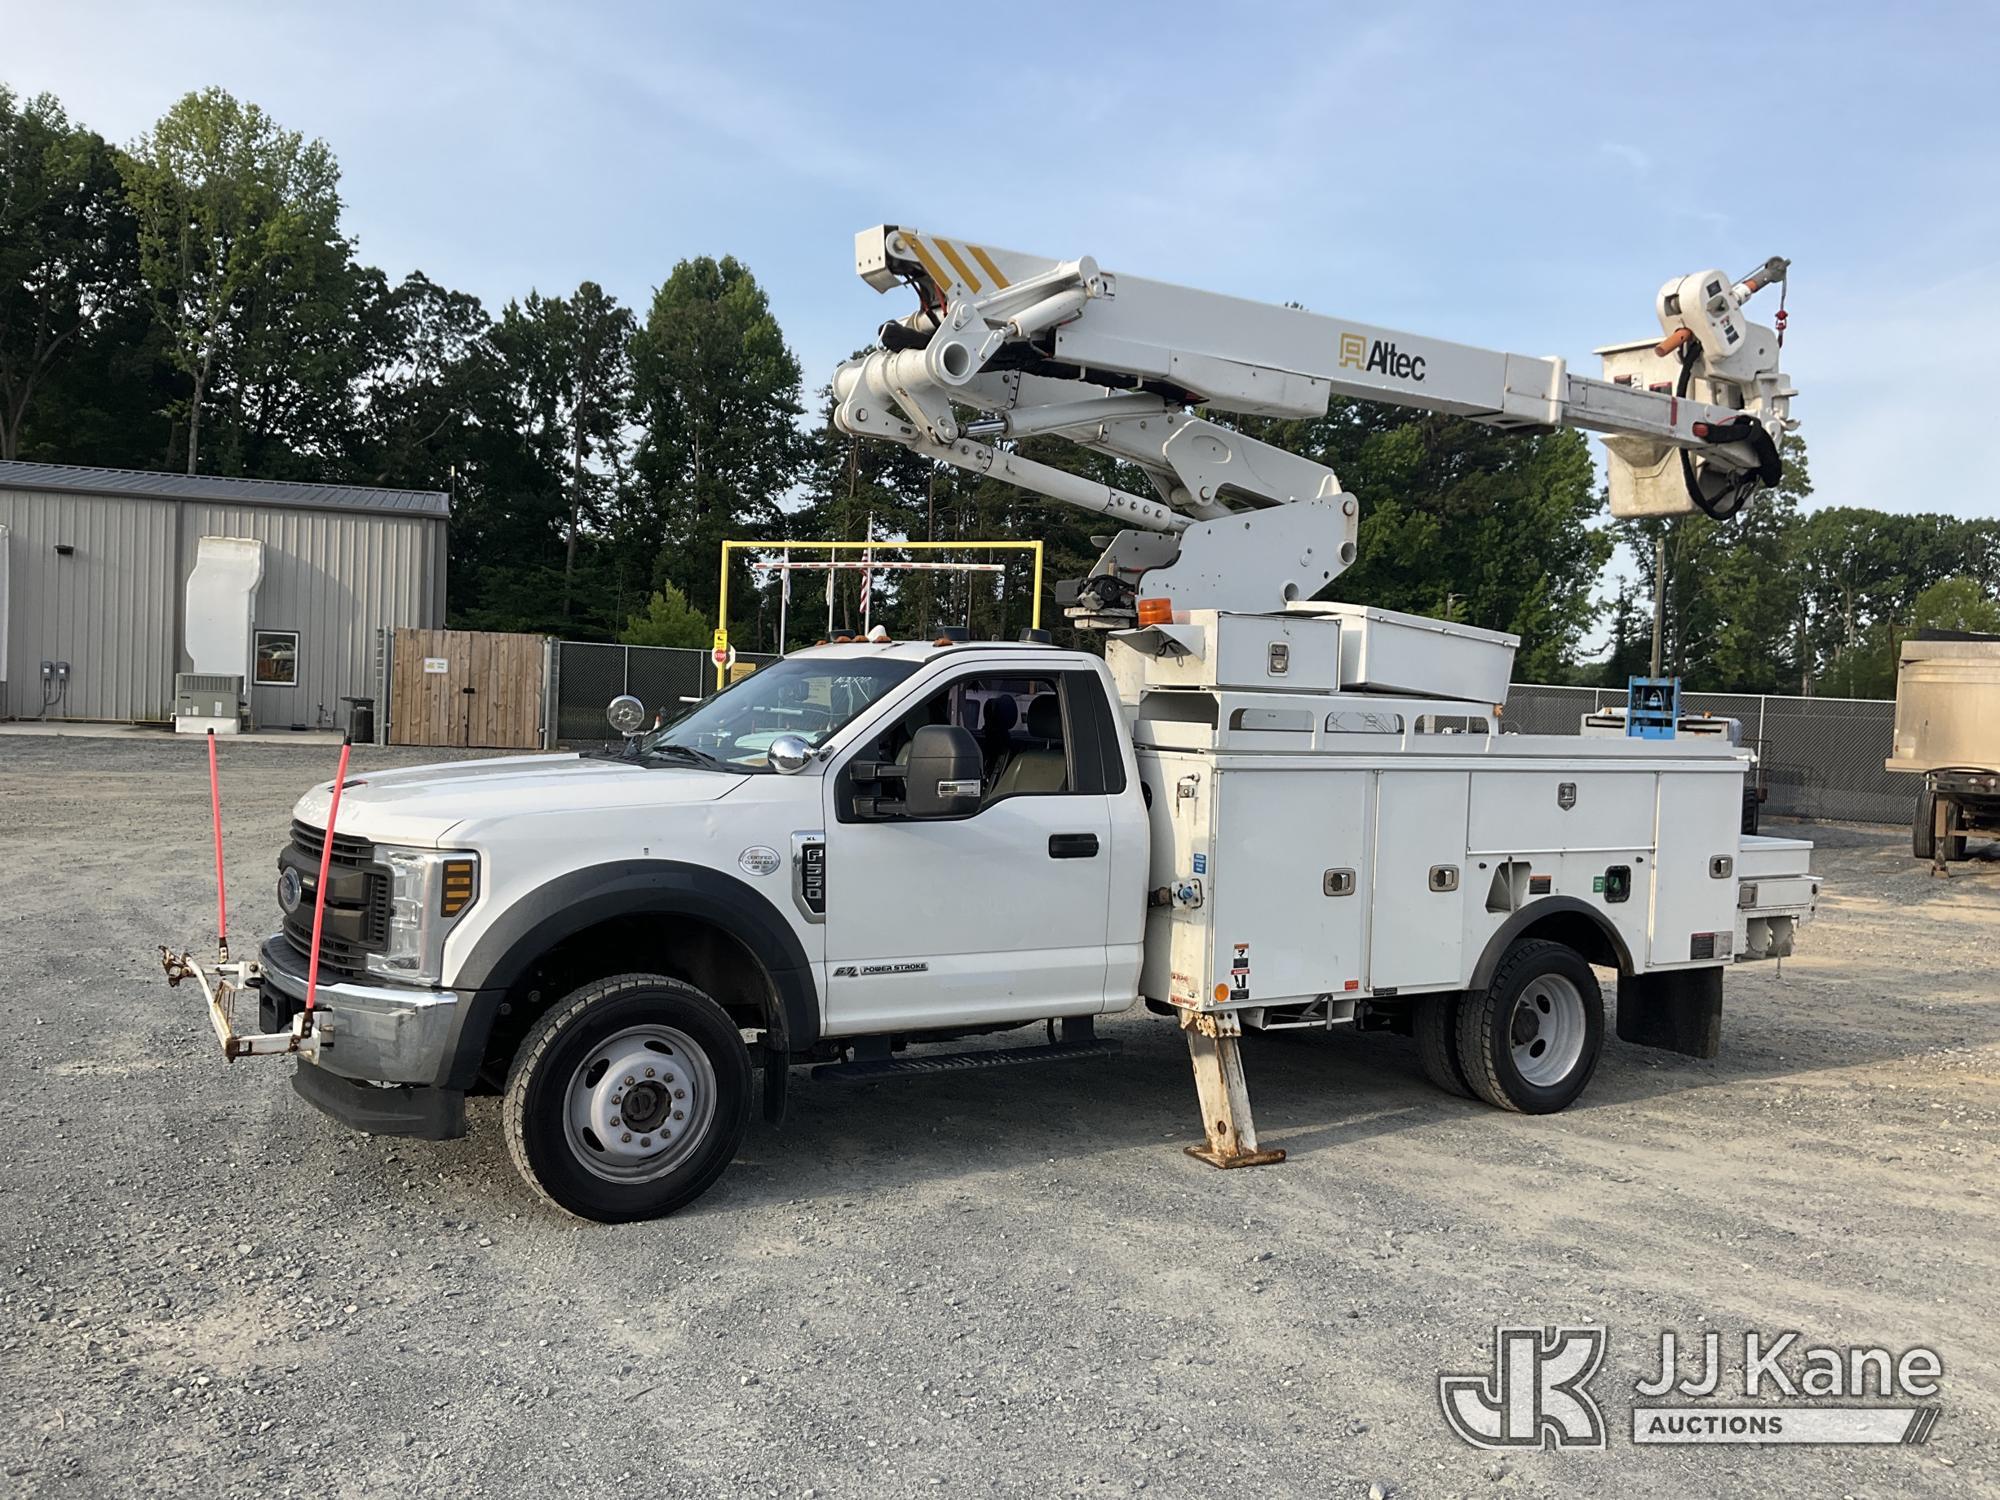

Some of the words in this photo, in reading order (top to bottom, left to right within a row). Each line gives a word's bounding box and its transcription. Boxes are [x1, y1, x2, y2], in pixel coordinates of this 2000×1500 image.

[1366, 340, 1426, 382] Altec
[863, 965, 892, 973] POWER
[894, 963, 927, 971] STROKE
